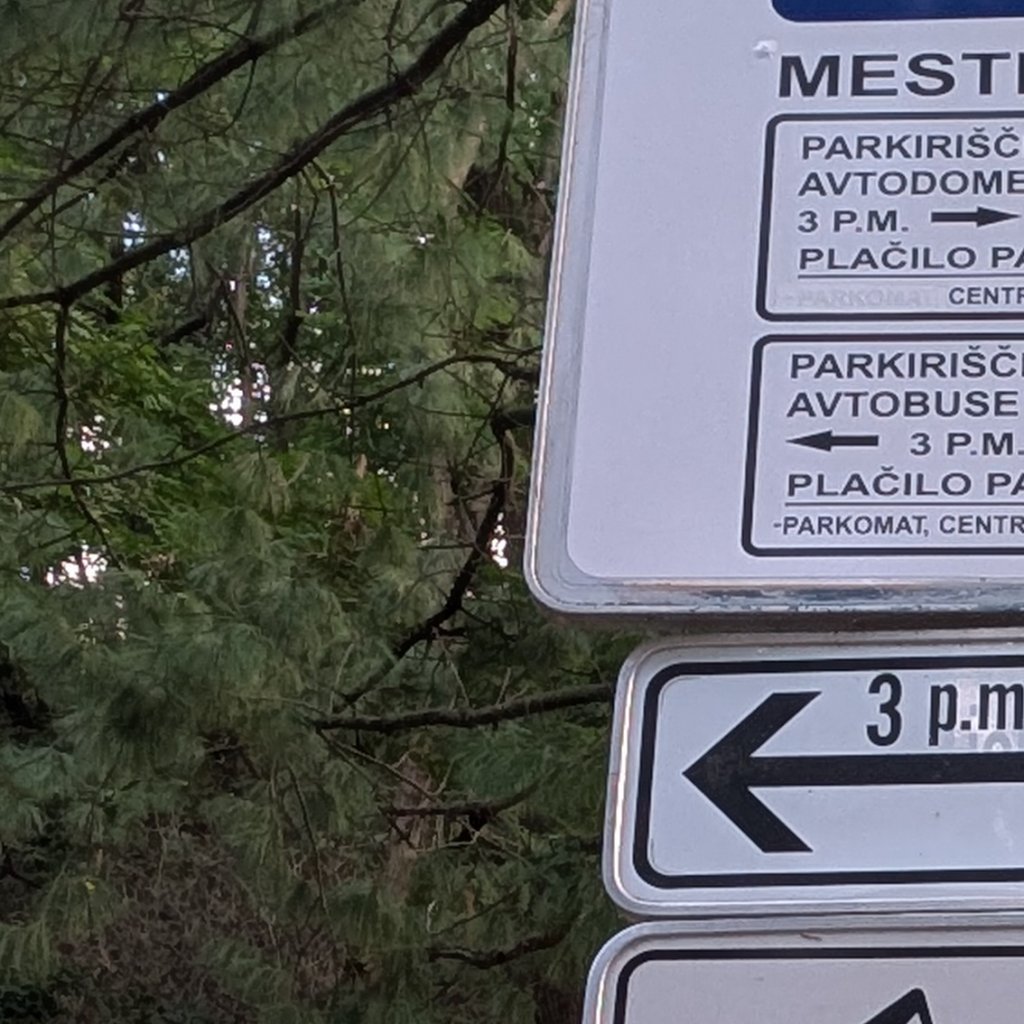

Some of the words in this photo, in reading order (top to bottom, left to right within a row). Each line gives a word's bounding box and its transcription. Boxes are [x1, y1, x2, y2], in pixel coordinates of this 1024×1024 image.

[798, 210, 819, 232] 3
[834, 208, 909, 232] P.M.
[800, 241, 976, 270] PLAČILO
[787, 390, 1019, 418] AVTOBUSE
[910, 432, 931, 456] 3
[787, 466, 971, 496] PLAČILO
[866, 673, 902, 746] 3
